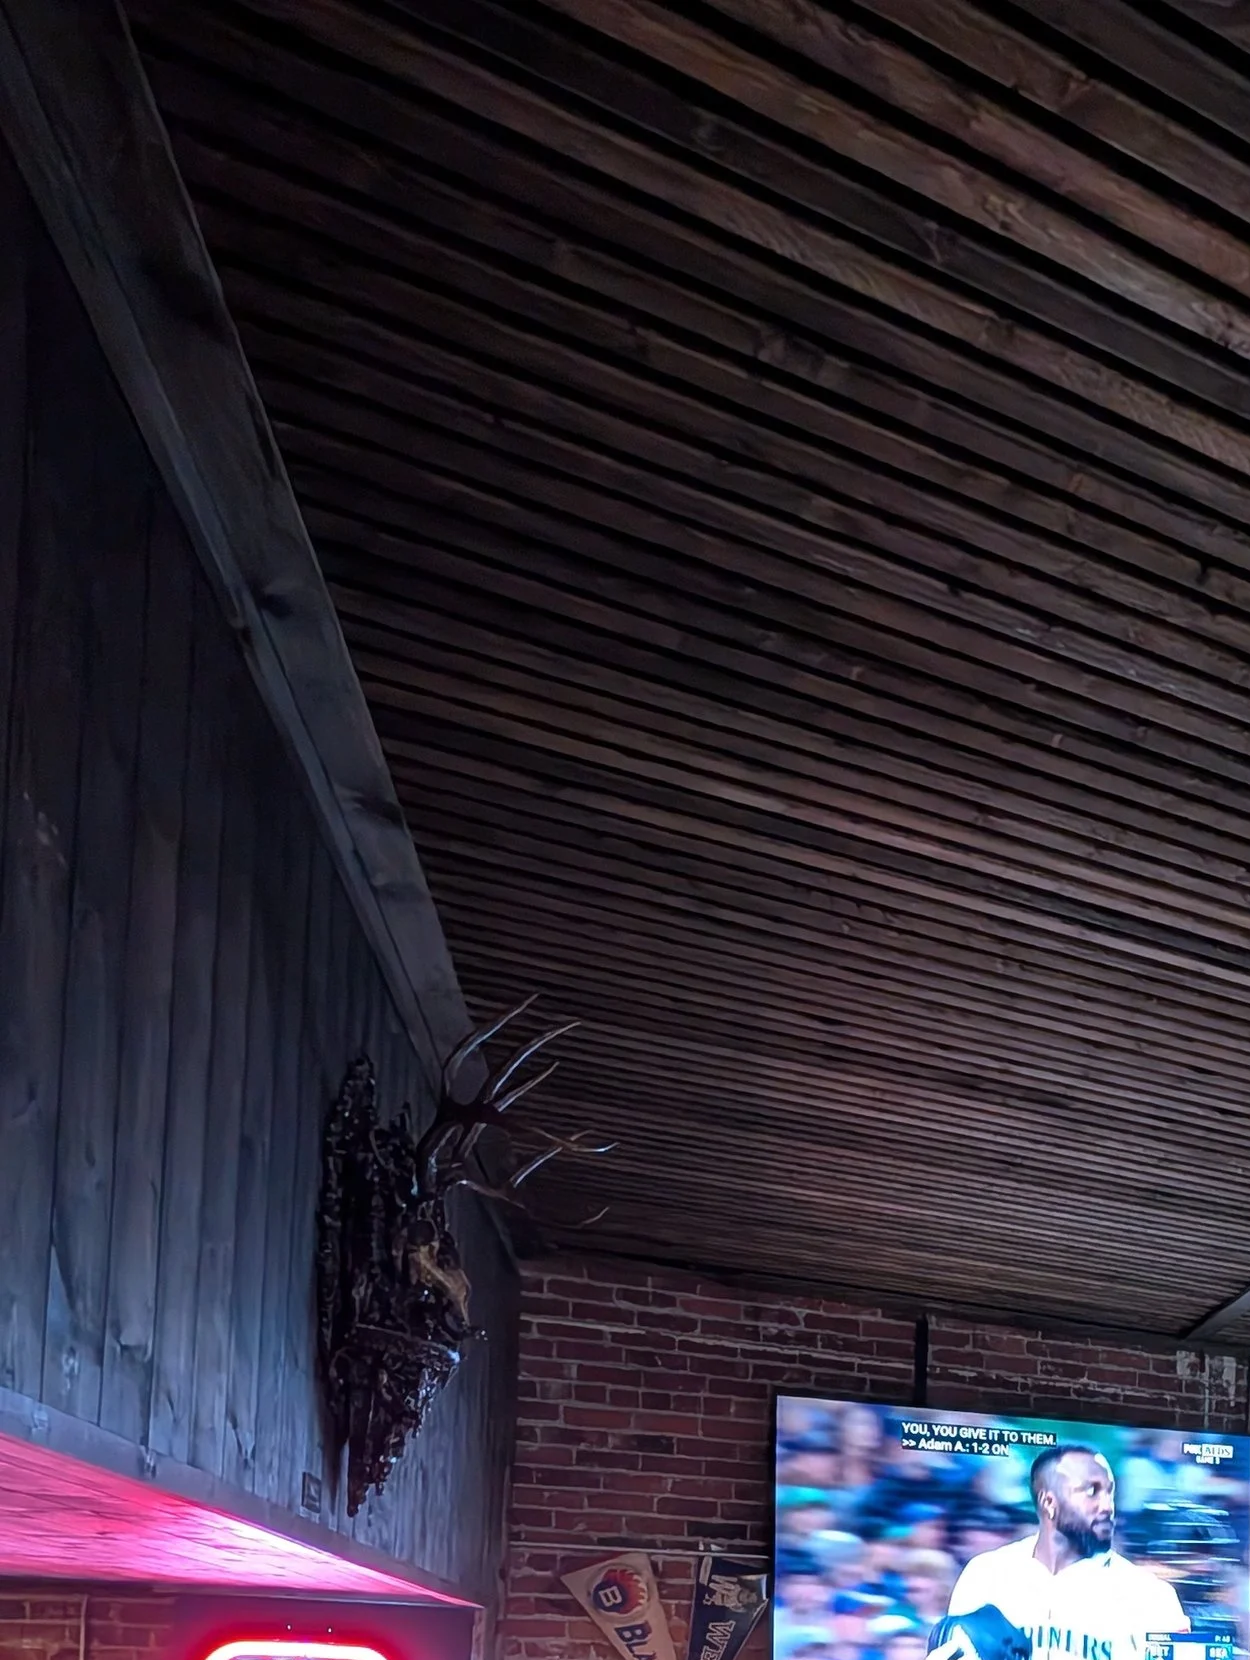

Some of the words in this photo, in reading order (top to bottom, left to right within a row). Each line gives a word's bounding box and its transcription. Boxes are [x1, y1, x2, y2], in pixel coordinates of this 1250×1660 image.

[902, 1422, 930, 1437] YOU,
[932, 1424, 957, 1438] YOU
[959, 1427, 987, 1440] GIVE
[988, 1430, 1000, 1441] IT
[1001, 1431, 1018, 1442] TO
[1020, 1432, 1056, 1446] THEM.
[918, 1438, 952, 1452] Adam
[972, 1443, 989, 1455] 1-2
[991, 1445, 1009, 1456] ON
